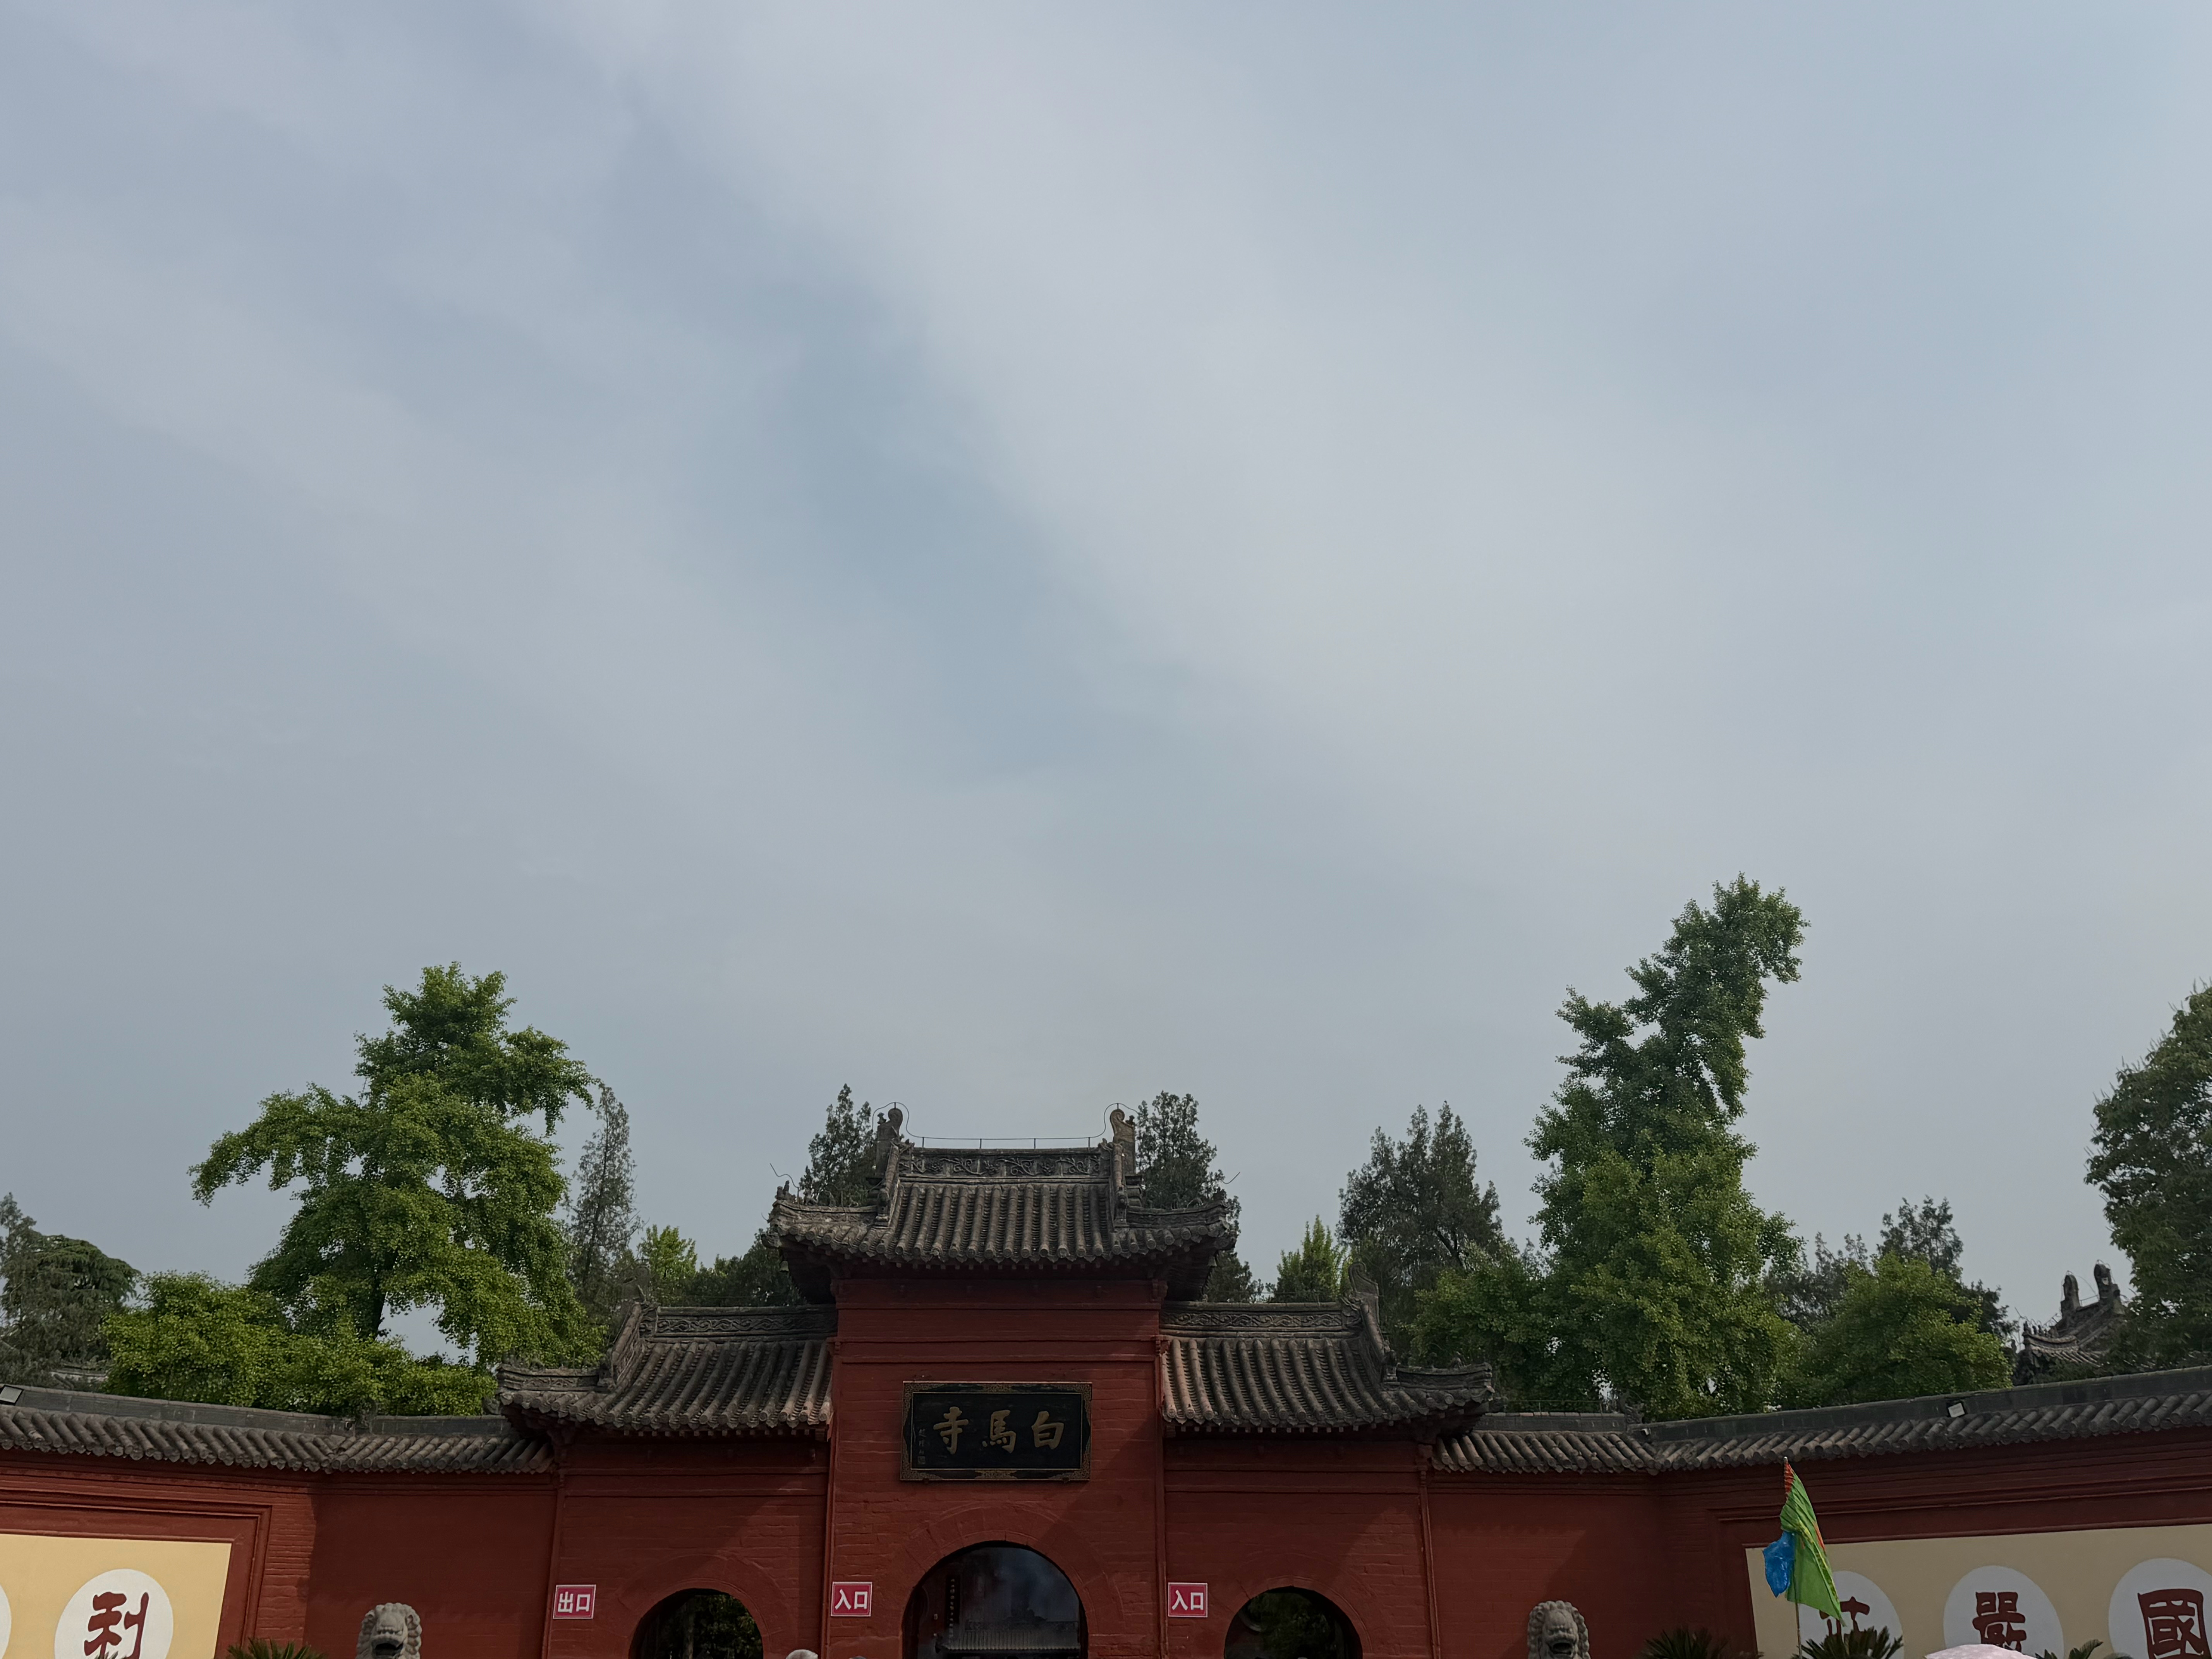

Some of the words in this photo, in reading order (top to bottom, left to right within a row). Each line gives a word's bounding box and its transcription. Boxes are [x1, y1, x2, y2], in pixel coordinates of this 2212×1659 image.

[558, 1592, 591, 1613] 出口
[835, 1589, 868, 1610] 入口
[1172, 1590, 1204, 1611] 入口
[84, 1592, 149, 1659] 利
